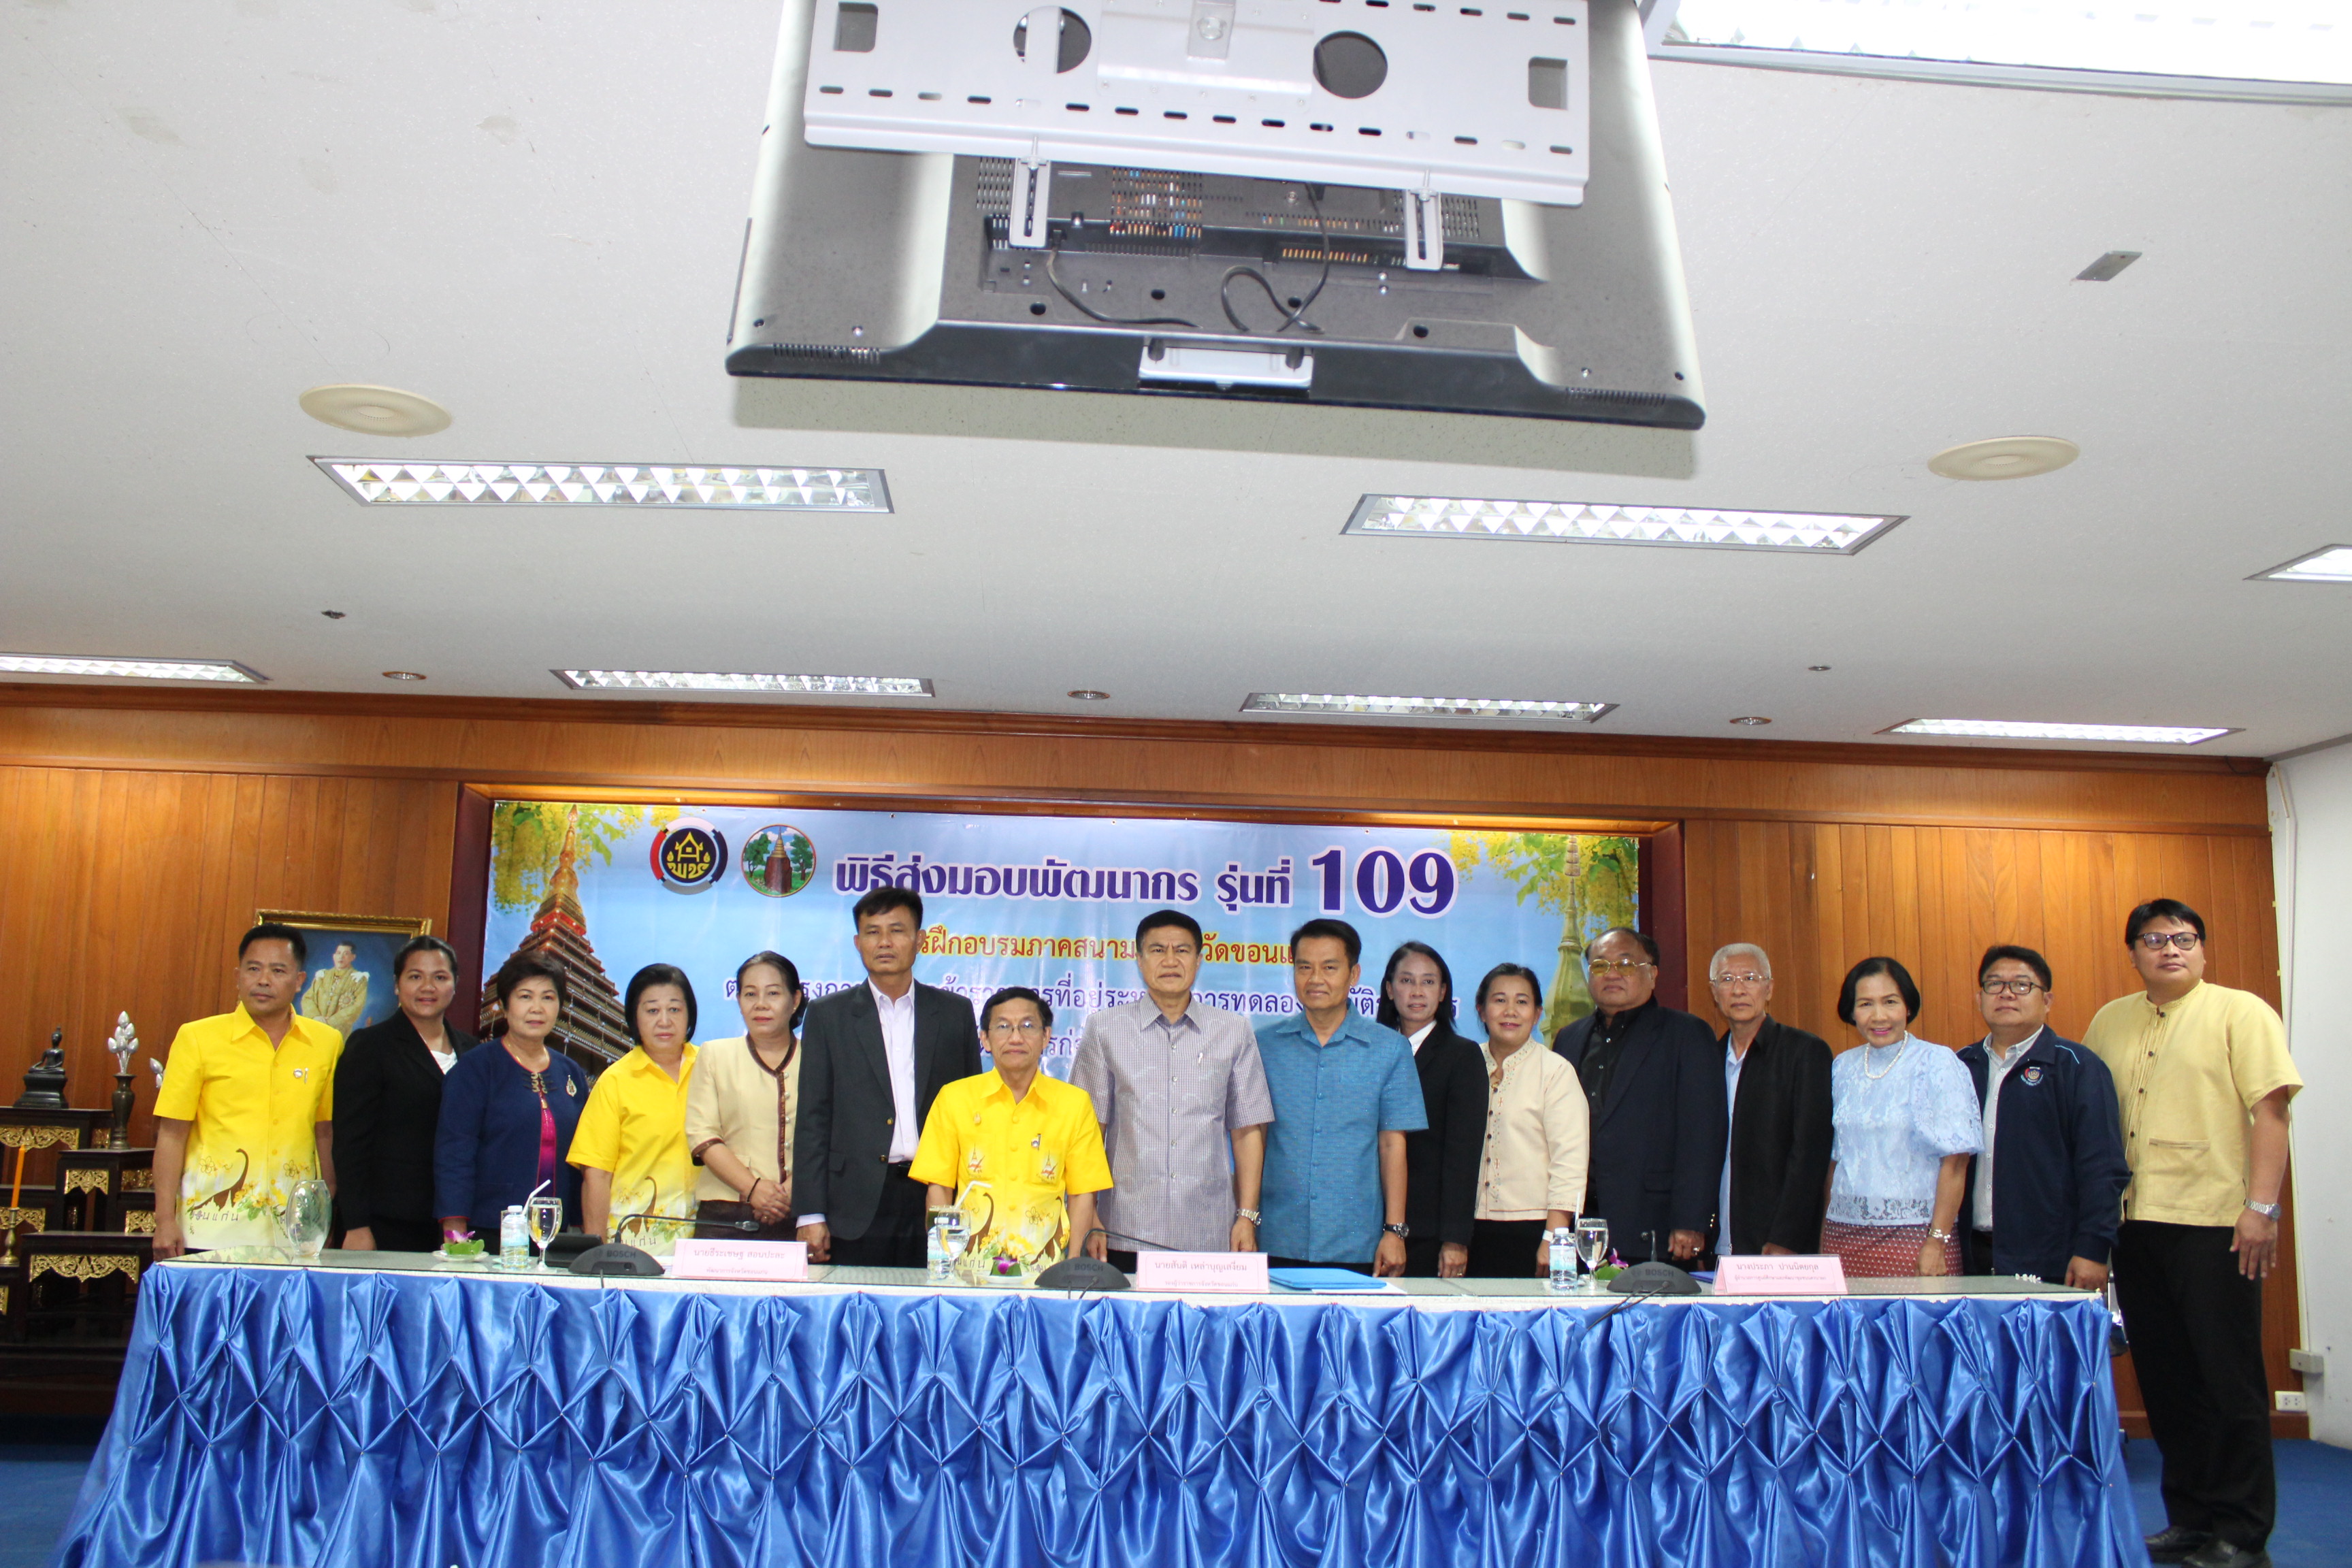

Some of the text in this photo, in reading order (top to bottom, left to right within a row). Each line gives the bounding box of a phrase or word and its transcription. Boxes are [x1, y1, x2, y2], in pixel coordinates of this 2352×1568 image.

[836, 849, 1454, 915] พิธีส่งมอบพัฒนากร รุ่นที่ 109
[606, 1250, 636, 1258] BOSCH
[1074, 1263, 1104, 1272] BOSCH
[1645, 1269, 1674, 1277] BOSCH
